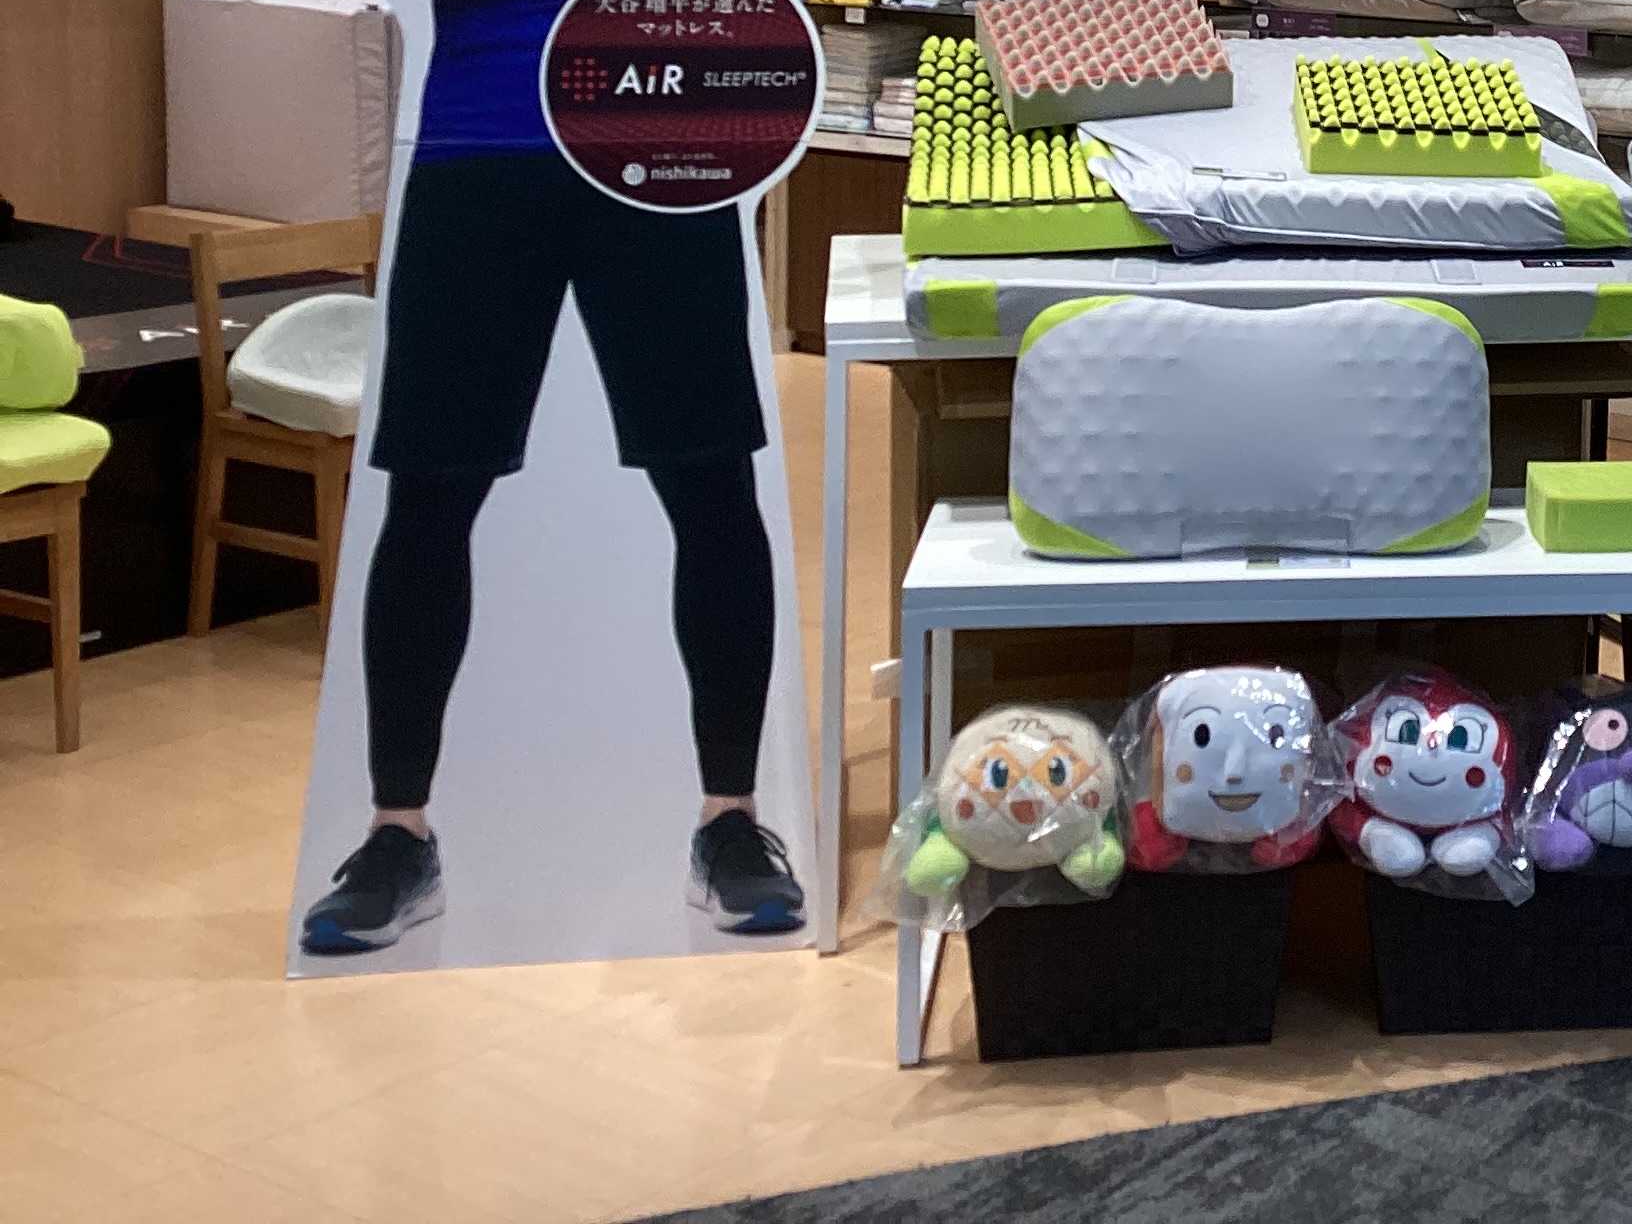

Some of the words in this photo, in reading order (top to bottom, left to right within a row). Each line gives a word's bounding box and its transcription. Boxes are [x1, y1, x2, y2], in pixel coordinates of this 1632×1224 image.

[637, 19, 734, 39] マットレス。
[615, 63, 685, 95] AiR
